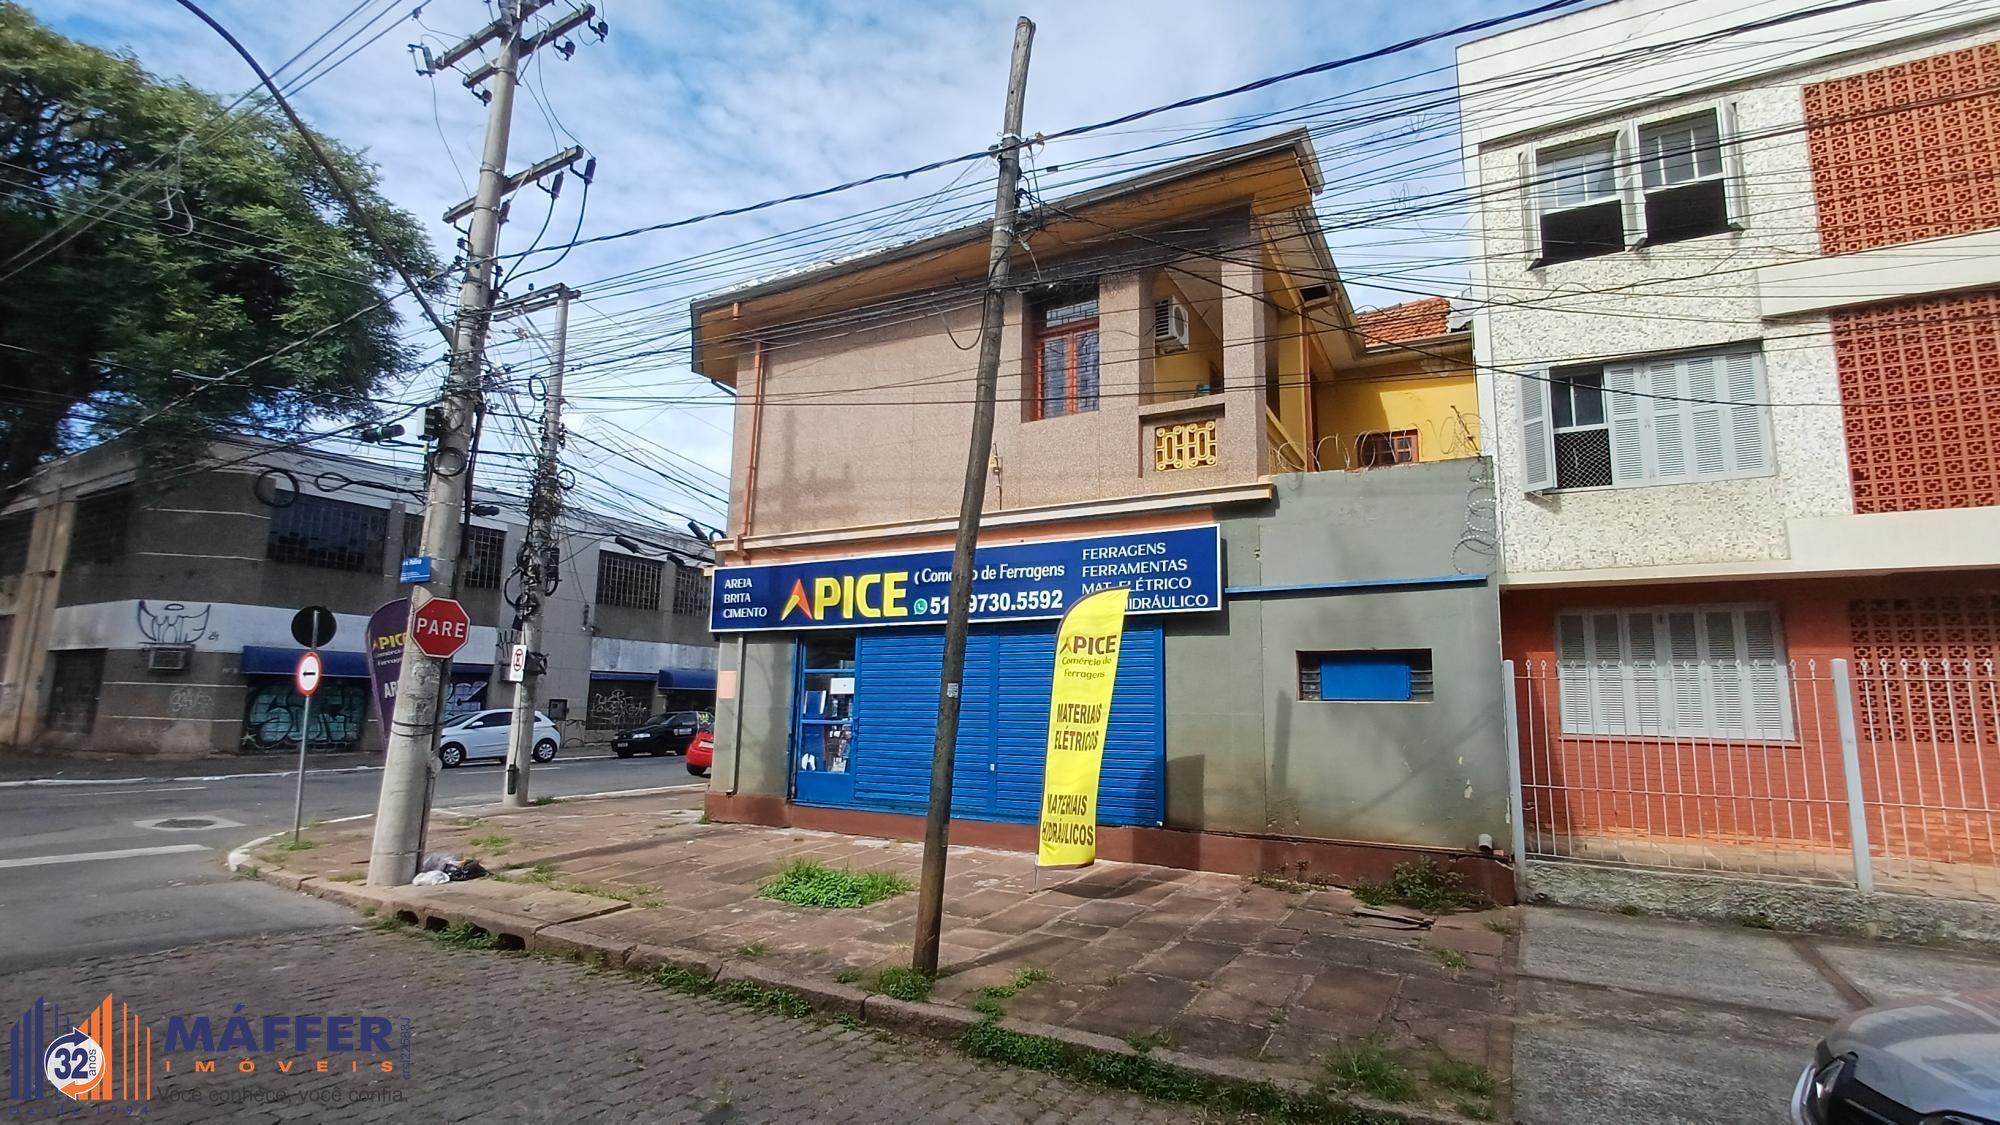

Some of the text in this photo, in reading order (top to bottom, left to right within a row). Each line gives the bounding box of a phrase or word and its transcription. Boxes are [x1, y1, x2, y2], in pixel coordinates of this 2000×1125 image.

[1082, 542, 1167, 561] FERRAGENS
[981, 565, 997, 580] de
[1000, 563, 1065, 582] Ferragens
[1082, 558, 1188, 578] FERRAMENTAS
[724, 578, 752, 589] AREIA
[724, 592, 751, 604] BRITA
[930, 589, 1063, 615] 51 9730.5592
[723, 607, 767, 619] CIMENTO
[416, 617, 466, 639] PARE
[1062, 656, 1101, 666] Comércio
